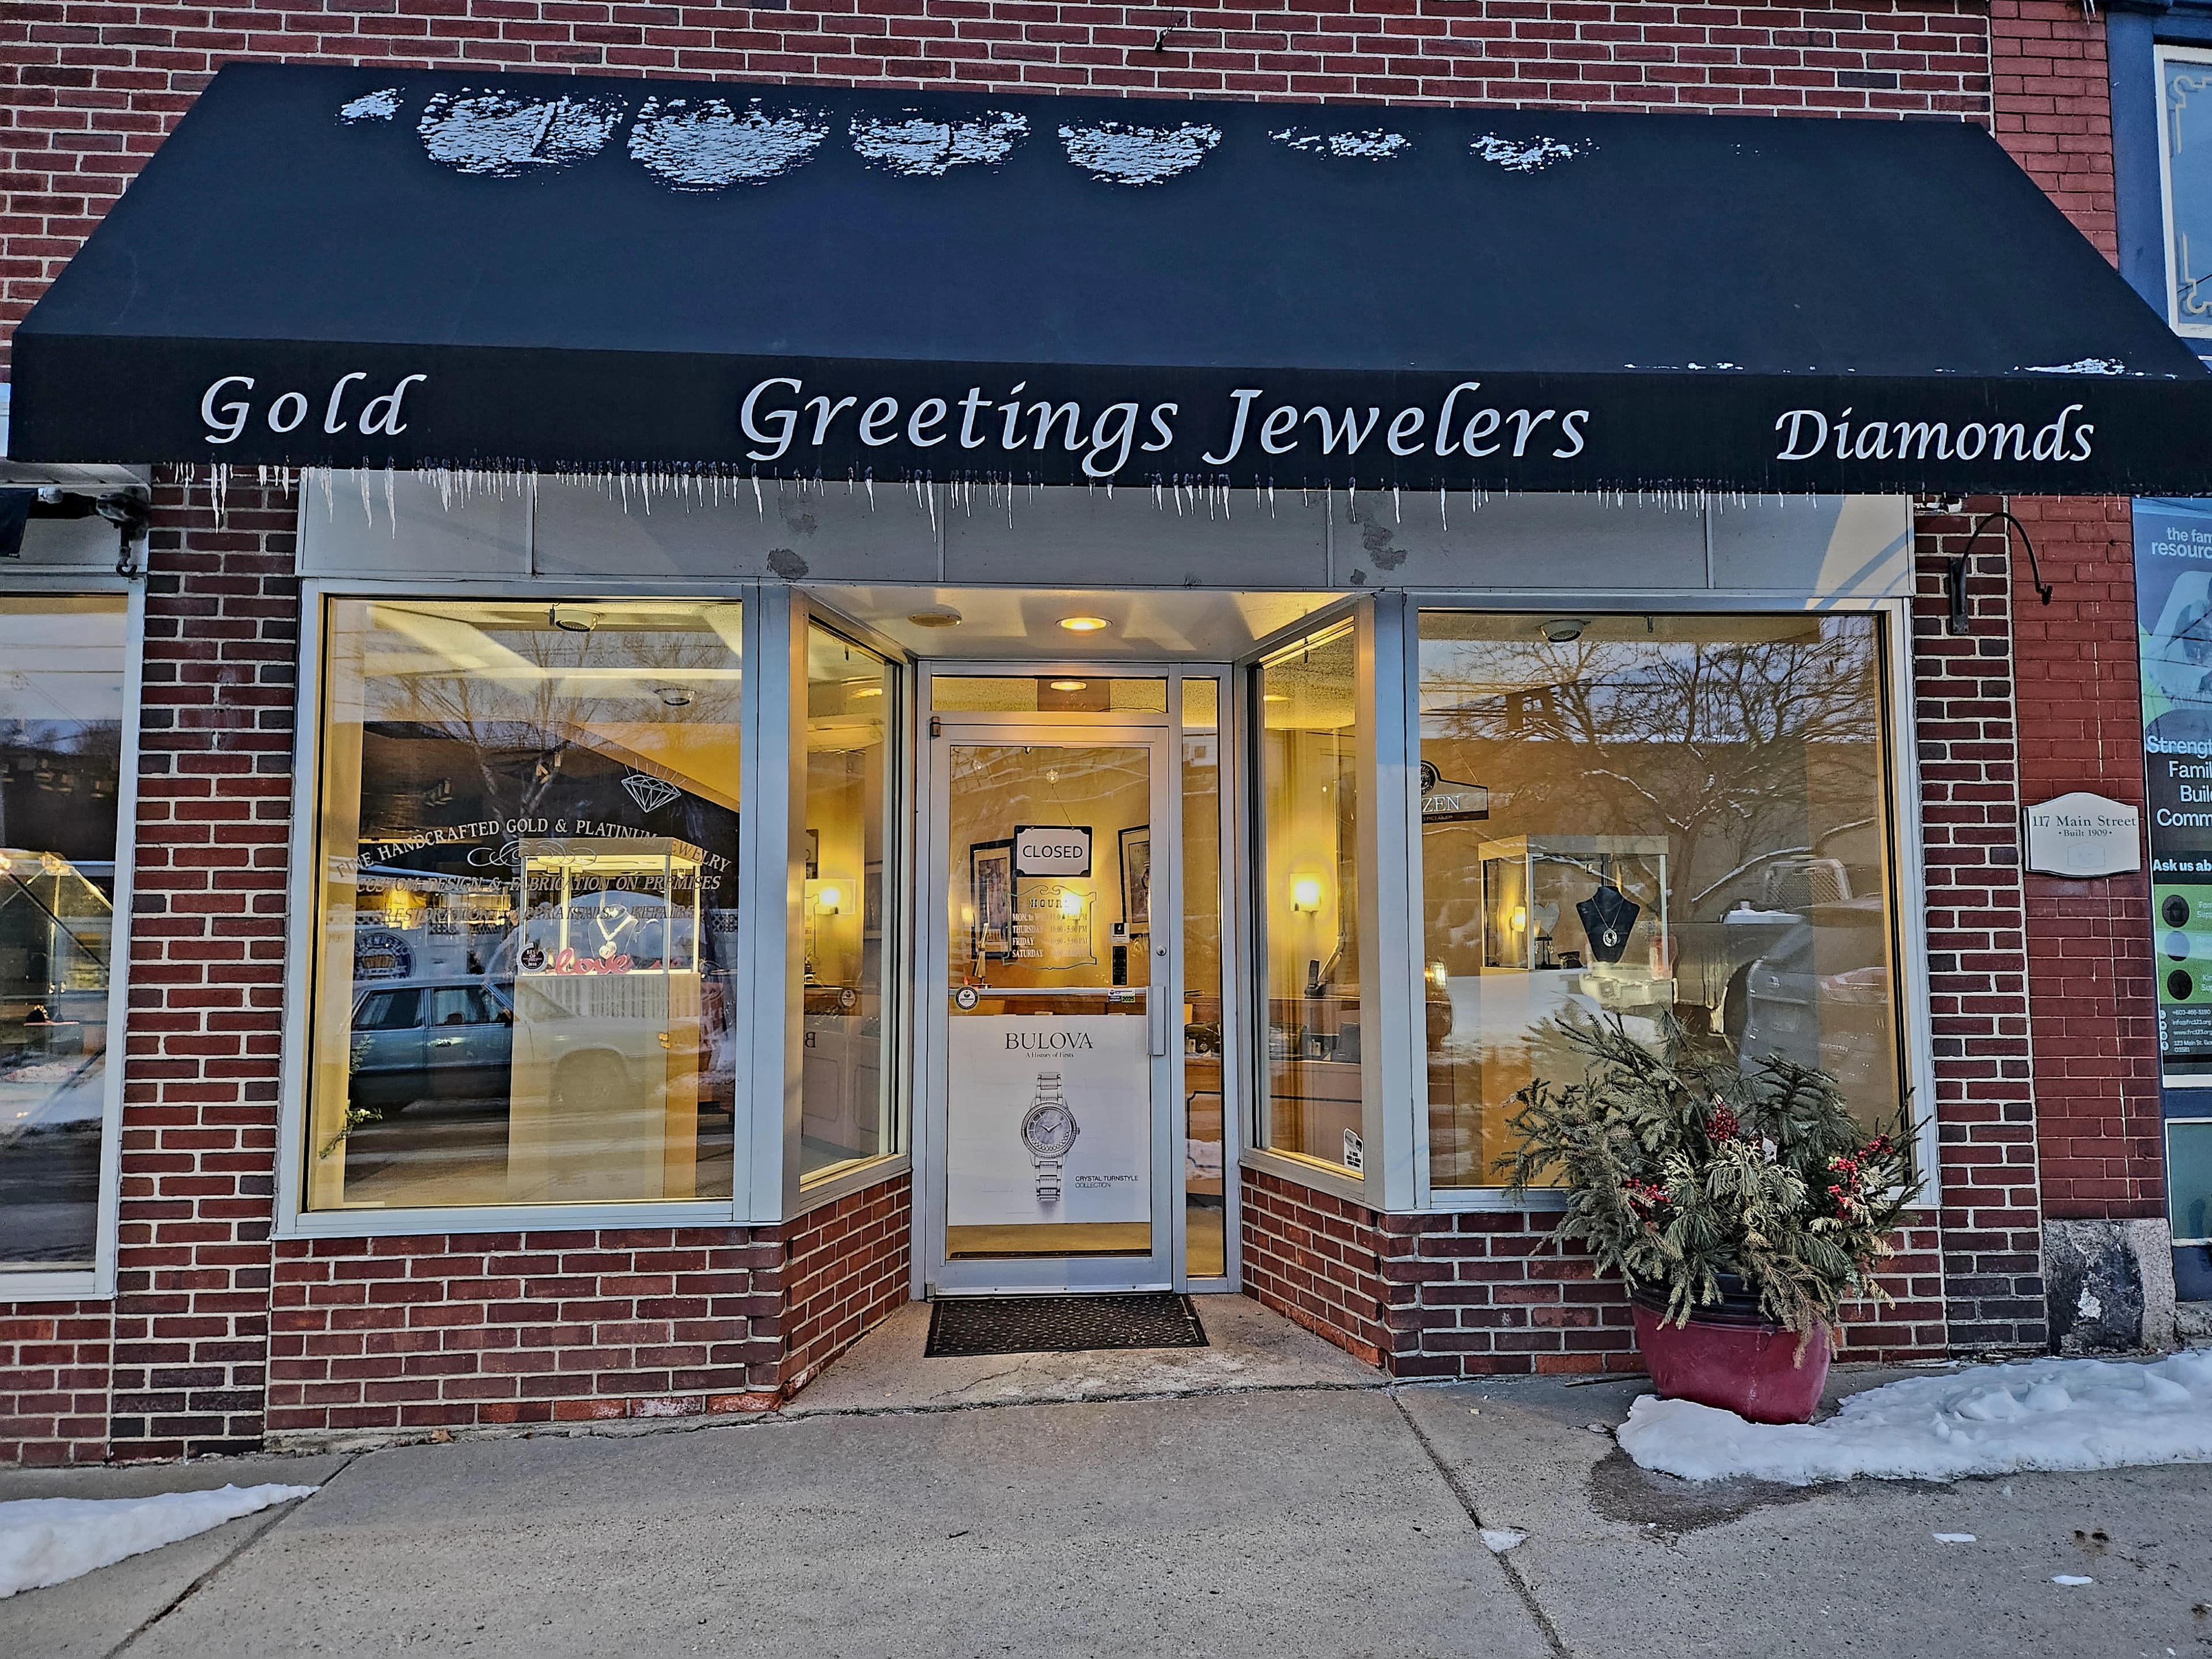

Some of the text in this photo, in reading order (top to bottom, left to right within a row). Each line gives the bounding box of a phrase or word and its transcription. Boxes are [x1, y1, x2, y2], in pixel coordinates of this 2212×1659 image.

[200, 372, 428, 444] Gold
[740, 377, 1590, 478] Greetings Jewelers
[1775, 404, 2094, 461] Diamonds
[2166, 527, 2188, 541] the
[2032, 815, 2137, 827] 117 Main Street
[336, 851, 374, 878] FINE
[376, 819, 500, 861] HANDCRAFTED
[506, 818, 548, 834] GOLD
[555, 818, 568, 833] &
[575, 819, 658, 847] PLATINUM
[1022, 845, 1083, 858] CLOSED
[2153, 858, 2212, 872] Ask us ab
[427, 876, 484, 892] DESIGN
[490, 877, 502, 891] &
[509, 876, 611, 891] FABRICATION
[615, 876, 639, 891] ON
[643, 875, 722, 890] PREMISES
[514, 906, 609, 920] PPRAISALS
[1012, 937, 1035, 945] FRIDAY
[1012, 949, 1044, 957] SATURDAY
[547, 947, 632, 975] love
[1005, 1032, 1094, 1050] BULOVA
